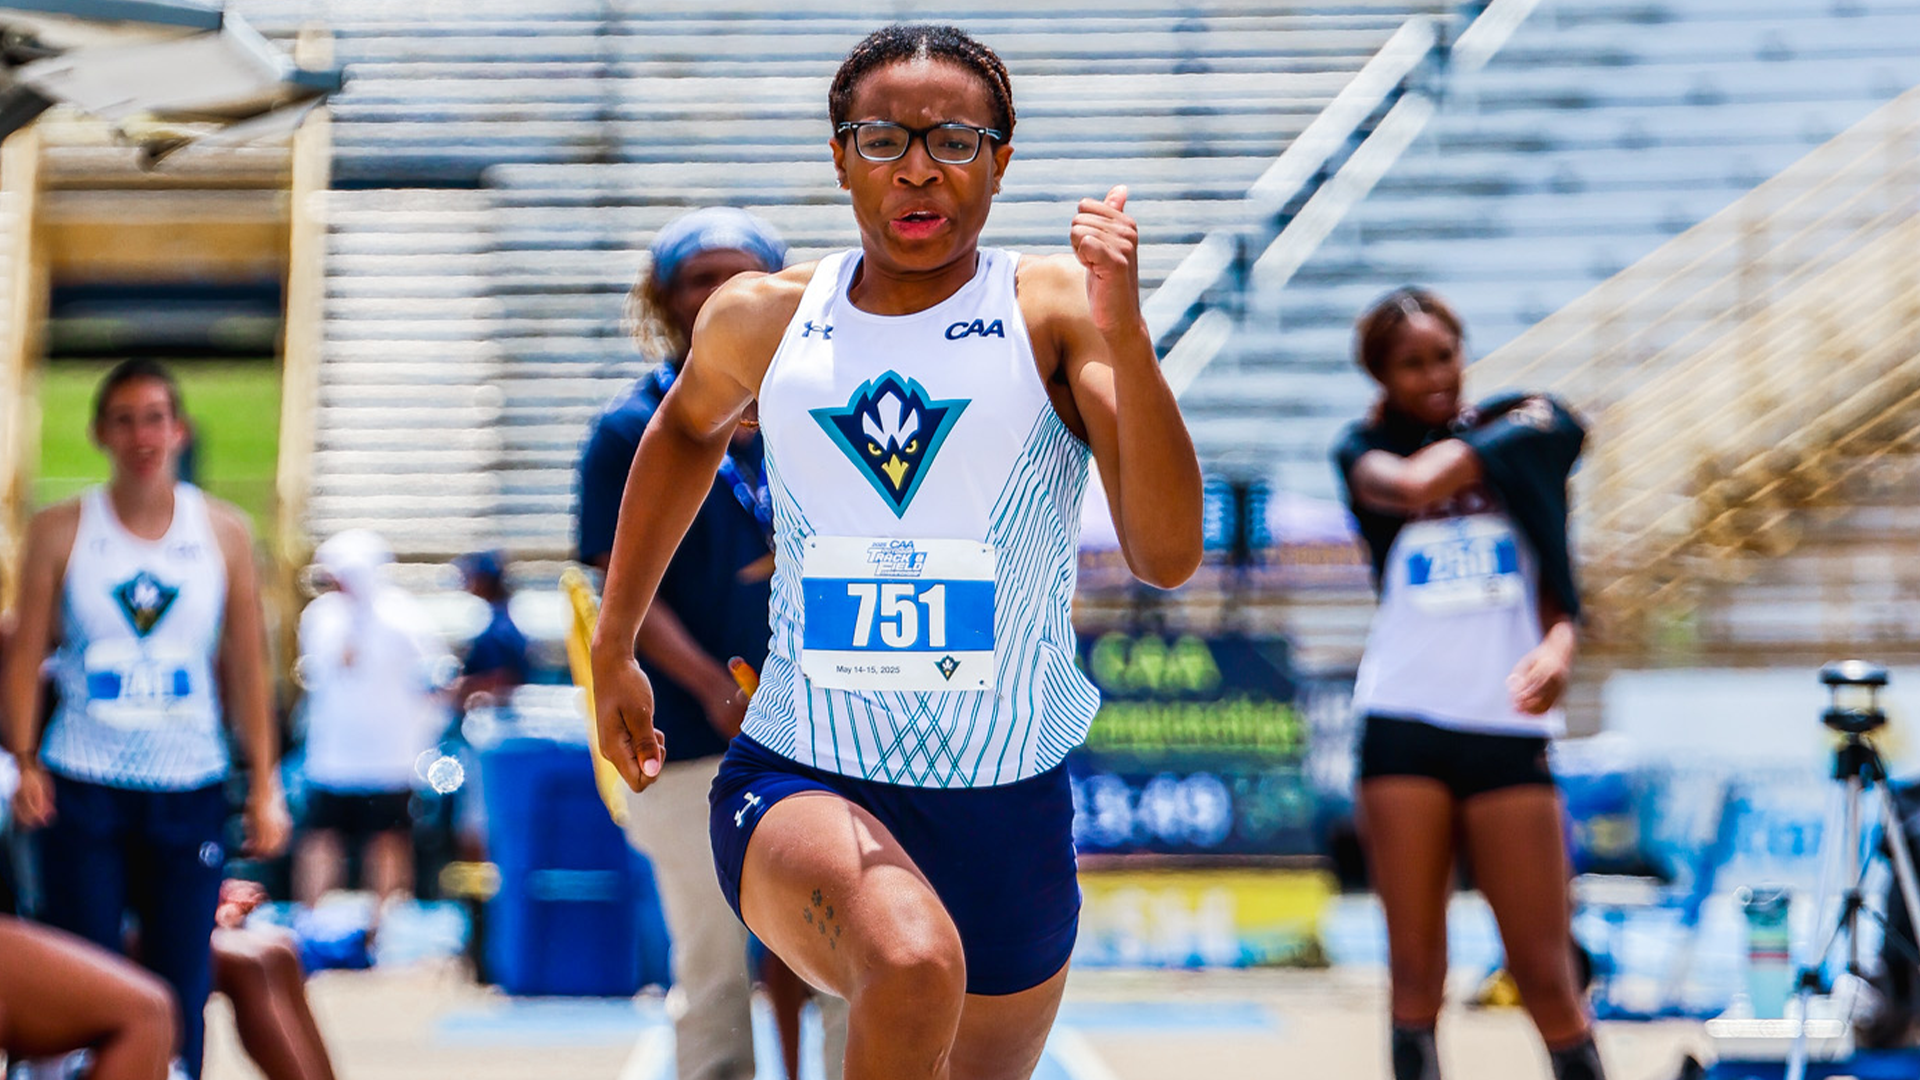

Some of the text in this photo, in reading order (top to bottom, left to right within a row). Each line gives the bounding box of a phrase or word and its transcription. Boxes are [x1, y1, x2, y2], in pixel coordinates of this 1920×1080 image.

[944, 318, 1005, 341] CAA
[889, 539, 914, 549] CAA
[867, 548, 911, 563] TRACK
[874, 562, 923, 576] FIELD
[847, 583, 946, 648] 751
[836, 665, 900, 674] May 14-15, 2025
